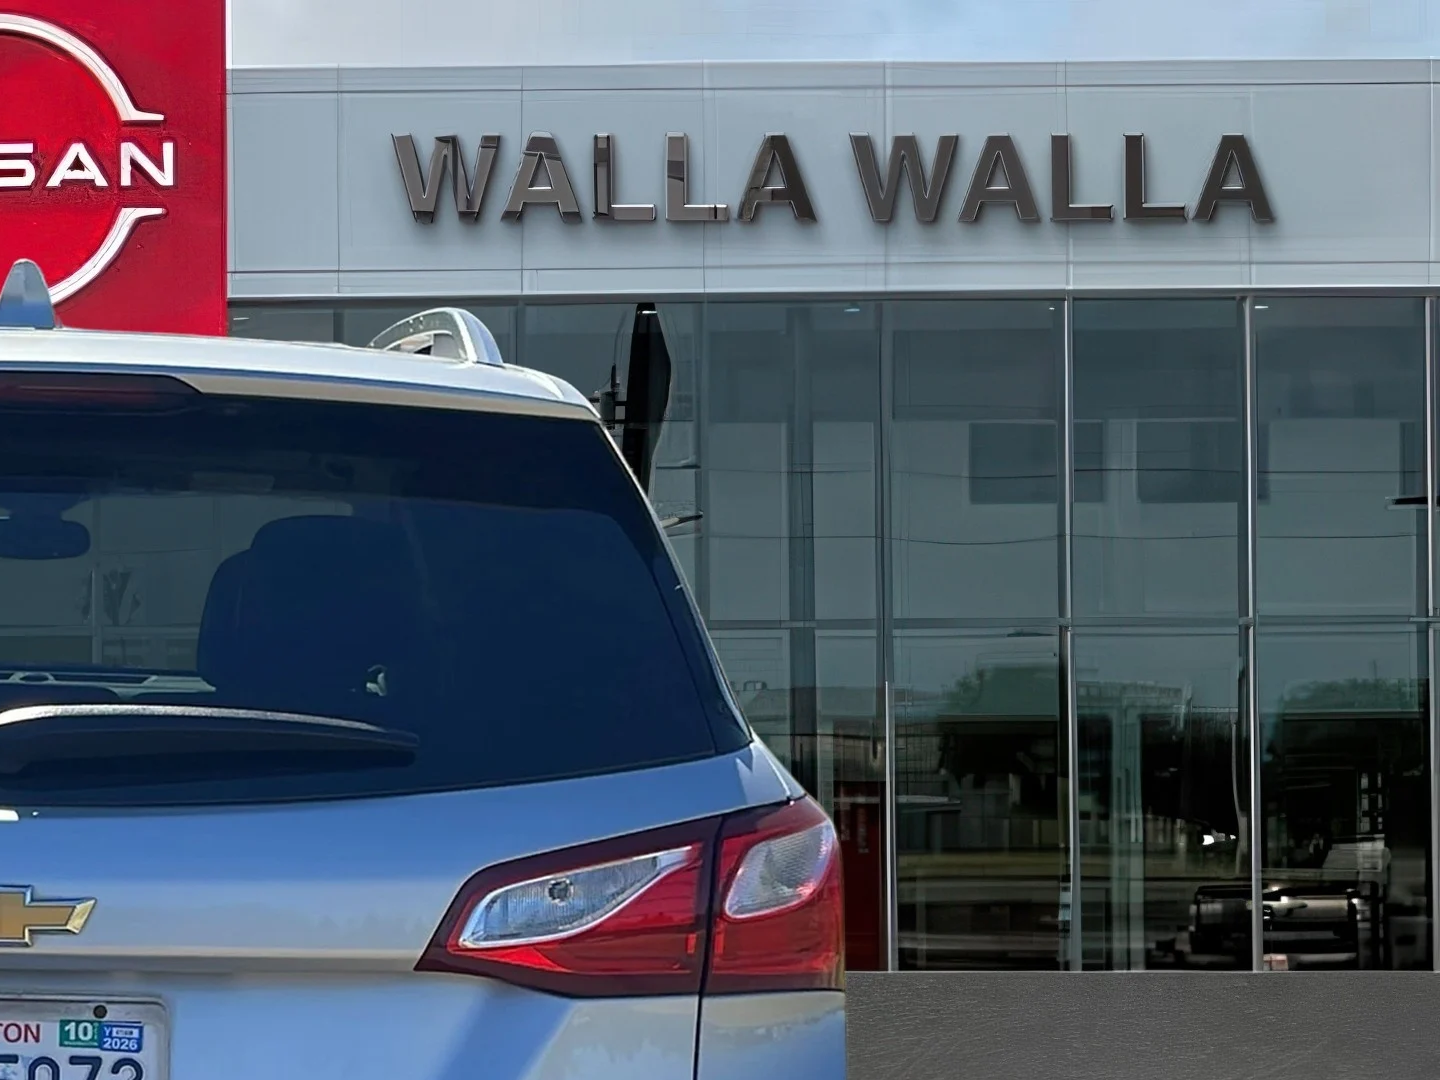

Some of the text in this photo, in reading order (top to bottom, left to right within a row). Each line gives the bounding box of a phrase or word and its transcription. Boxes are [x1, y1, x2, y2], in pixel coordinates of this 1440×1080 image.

[391, 131, 1277, 224] WALLA WALLA
[64, 1021, 93, 1041] 10
[102, 1038, 139, 1051] 2026
